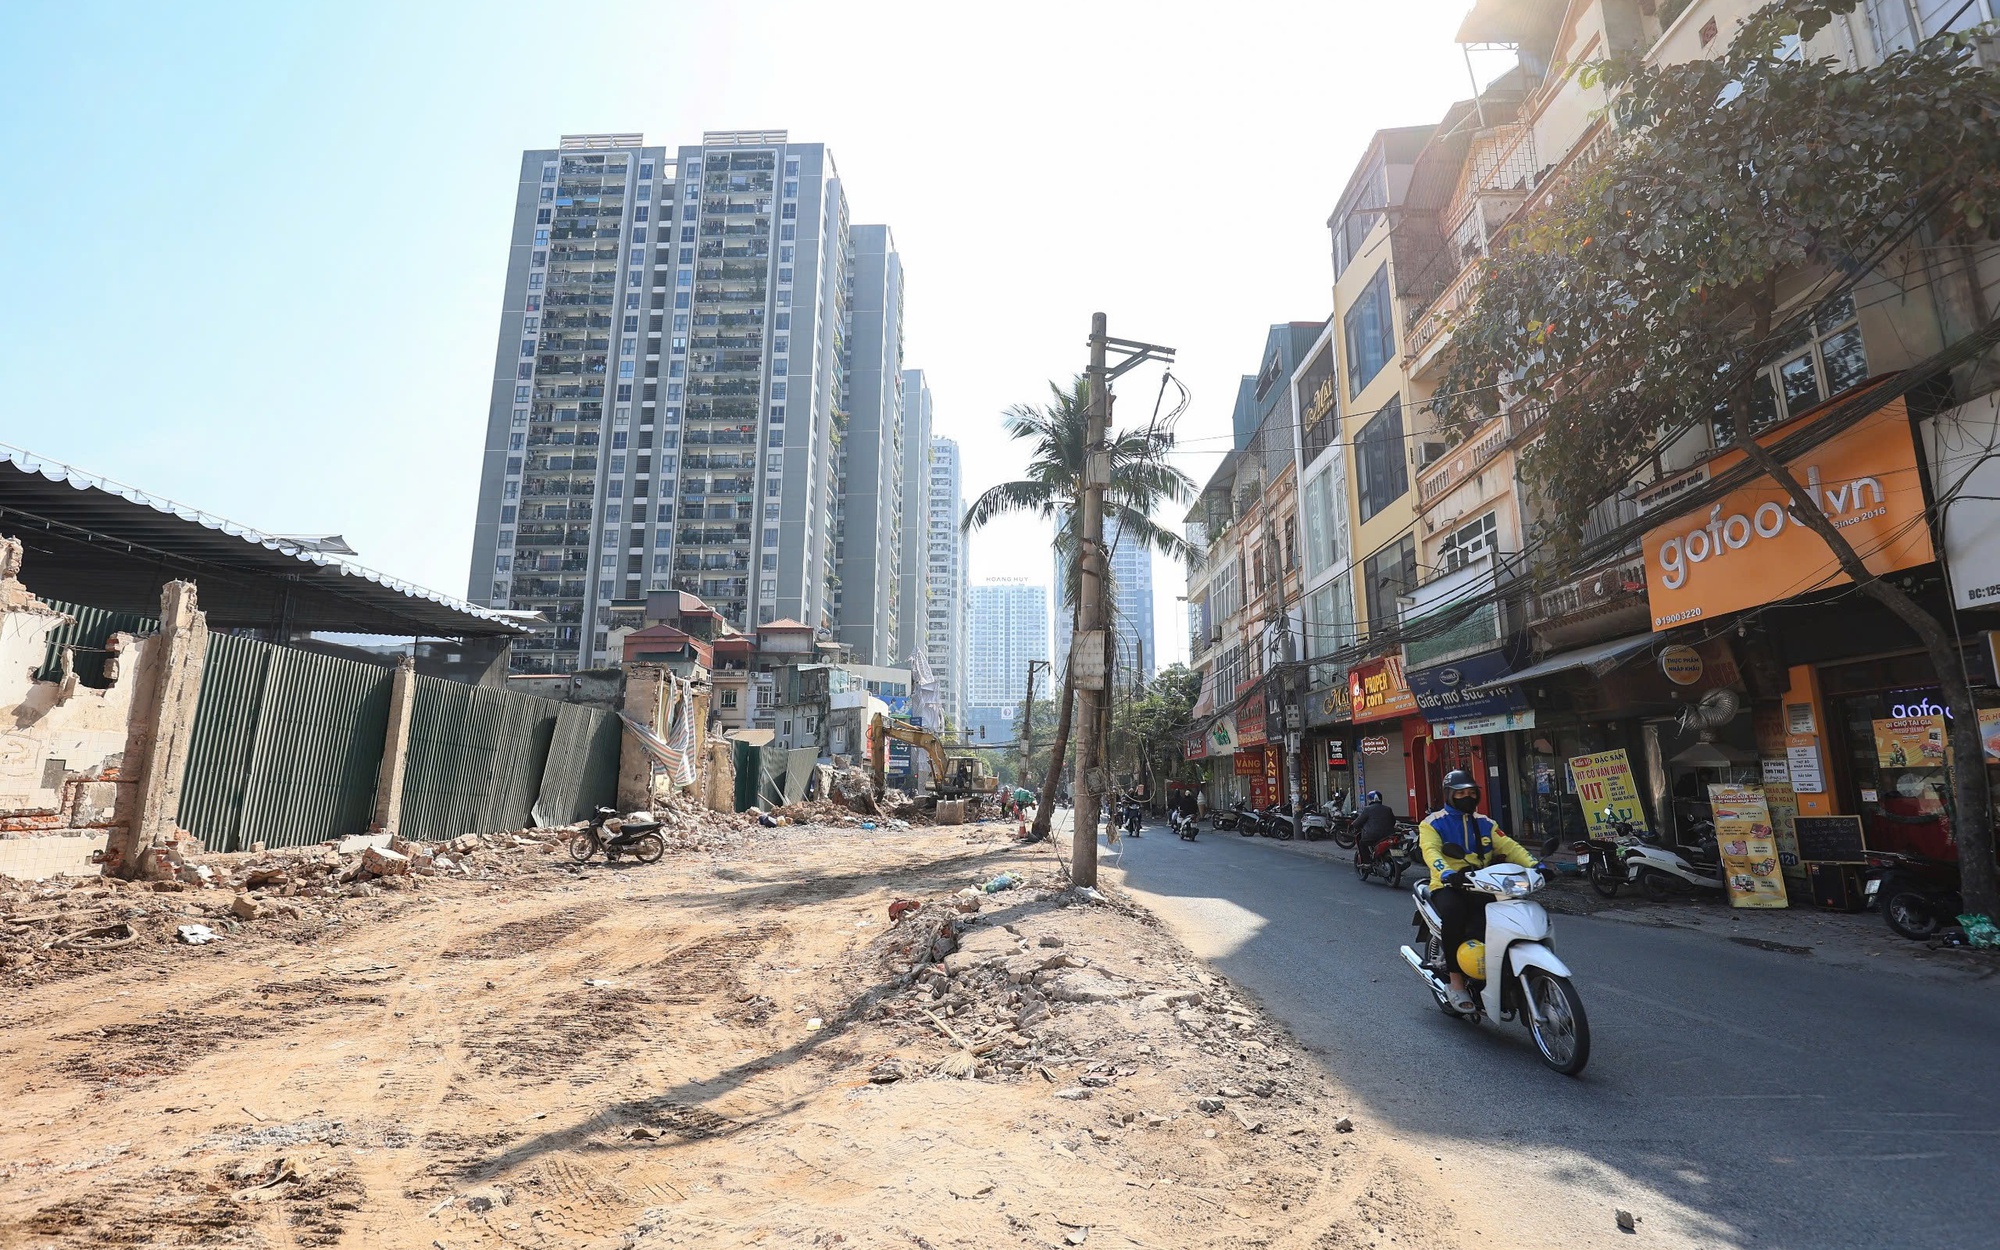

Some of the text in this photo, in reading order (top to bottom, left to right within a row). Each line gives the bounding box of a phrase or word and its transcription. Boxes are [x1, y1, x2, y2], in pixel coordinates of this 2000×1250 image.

[1832, 506, 1887, 529] Since 2016
[1364, 672, 1389, 694] PROPER
[1366, 692, 1384, 708] corn
[1416, 688, 1442, 709] Giấc
[1442, 689, 1460, 705] mơ
[1236, 757, 1261, 768] VÀNG
[1595, 752, 1624, 764] ĐẶC SẢN
[1580, 782, 1603, 803] VỊT
[1594, 803, 1632, 824] LẨU
[1781, 855, 1796, 865] 121
